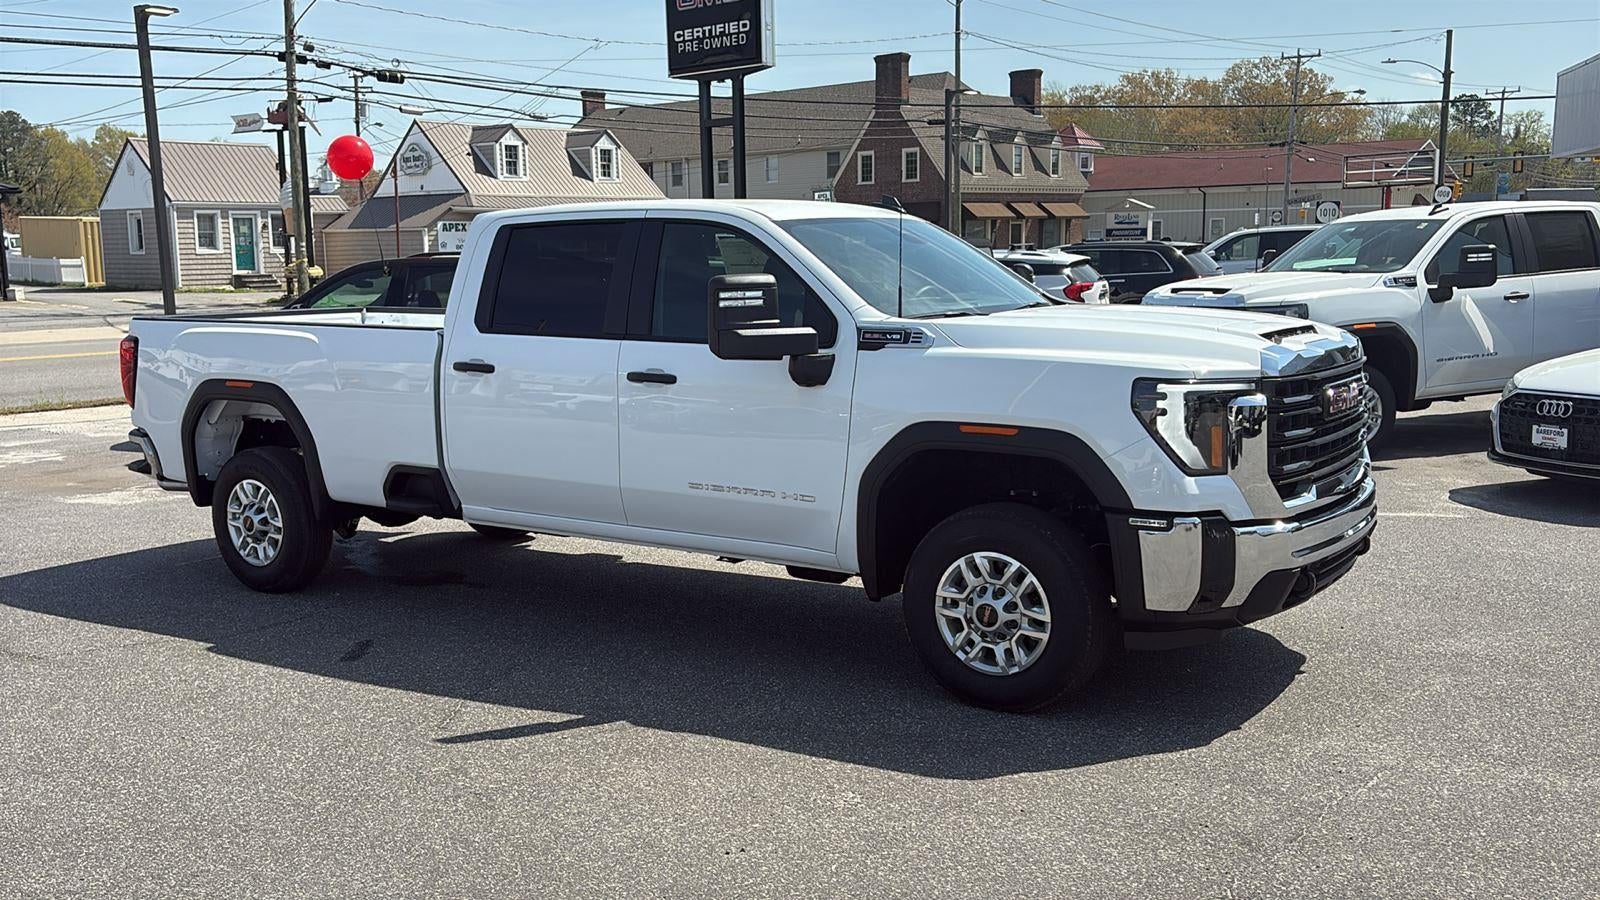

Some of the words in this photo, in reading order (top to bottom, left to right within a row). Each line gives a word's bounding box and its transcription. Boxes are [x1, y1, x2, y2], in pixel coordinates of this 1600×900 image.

[674, 20, 750, 42] CERTIFIED
[678, 34, 747, 54] PRE-OWNED
[1319, 207, 1337, 217] 1010
[442, 222, 467, 233] APEX
[1535, 427, 1565, 438] BAREFORD
[687, 482, 776, 498] SIERRA
[781, 491, 817, 503] HD
